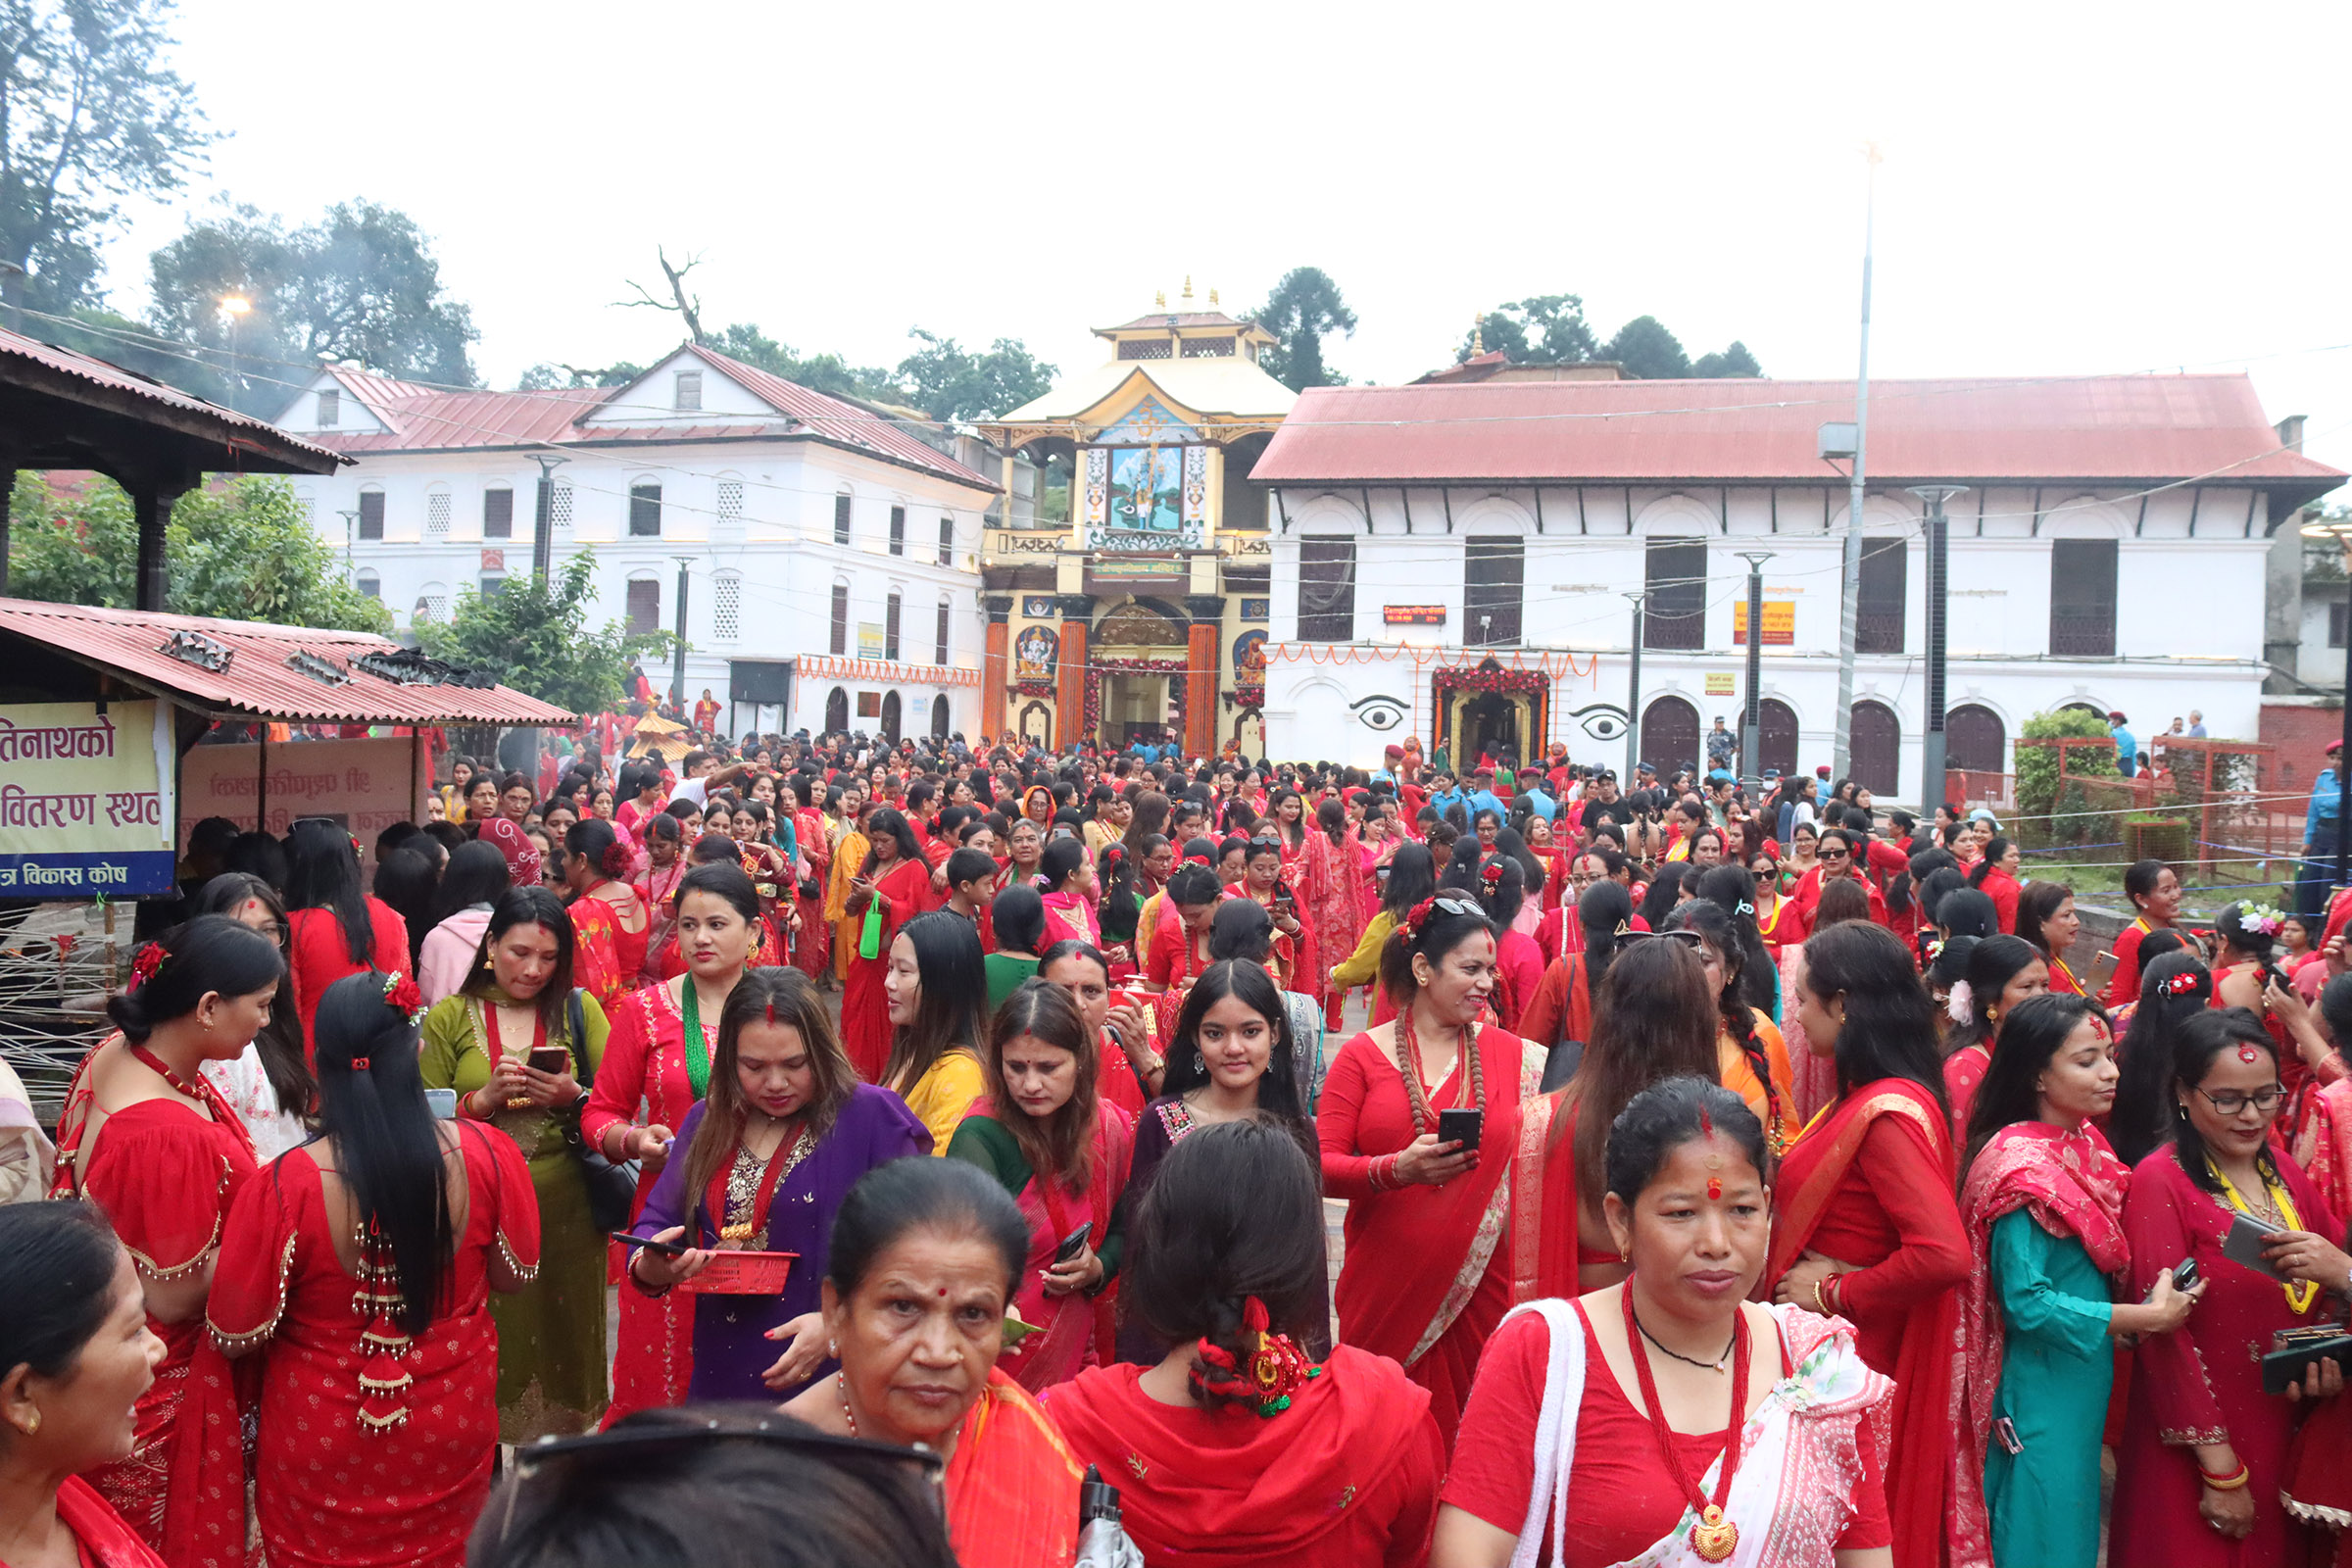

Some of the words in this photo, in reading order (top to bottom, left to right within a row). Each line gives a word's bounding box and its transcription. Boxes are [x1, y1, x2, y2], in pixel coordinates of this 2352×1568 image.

[1, 784, 97, 828] वितरण
[23, 862, 83, 886] विकास
[88, 861, 128, 884] कोष
